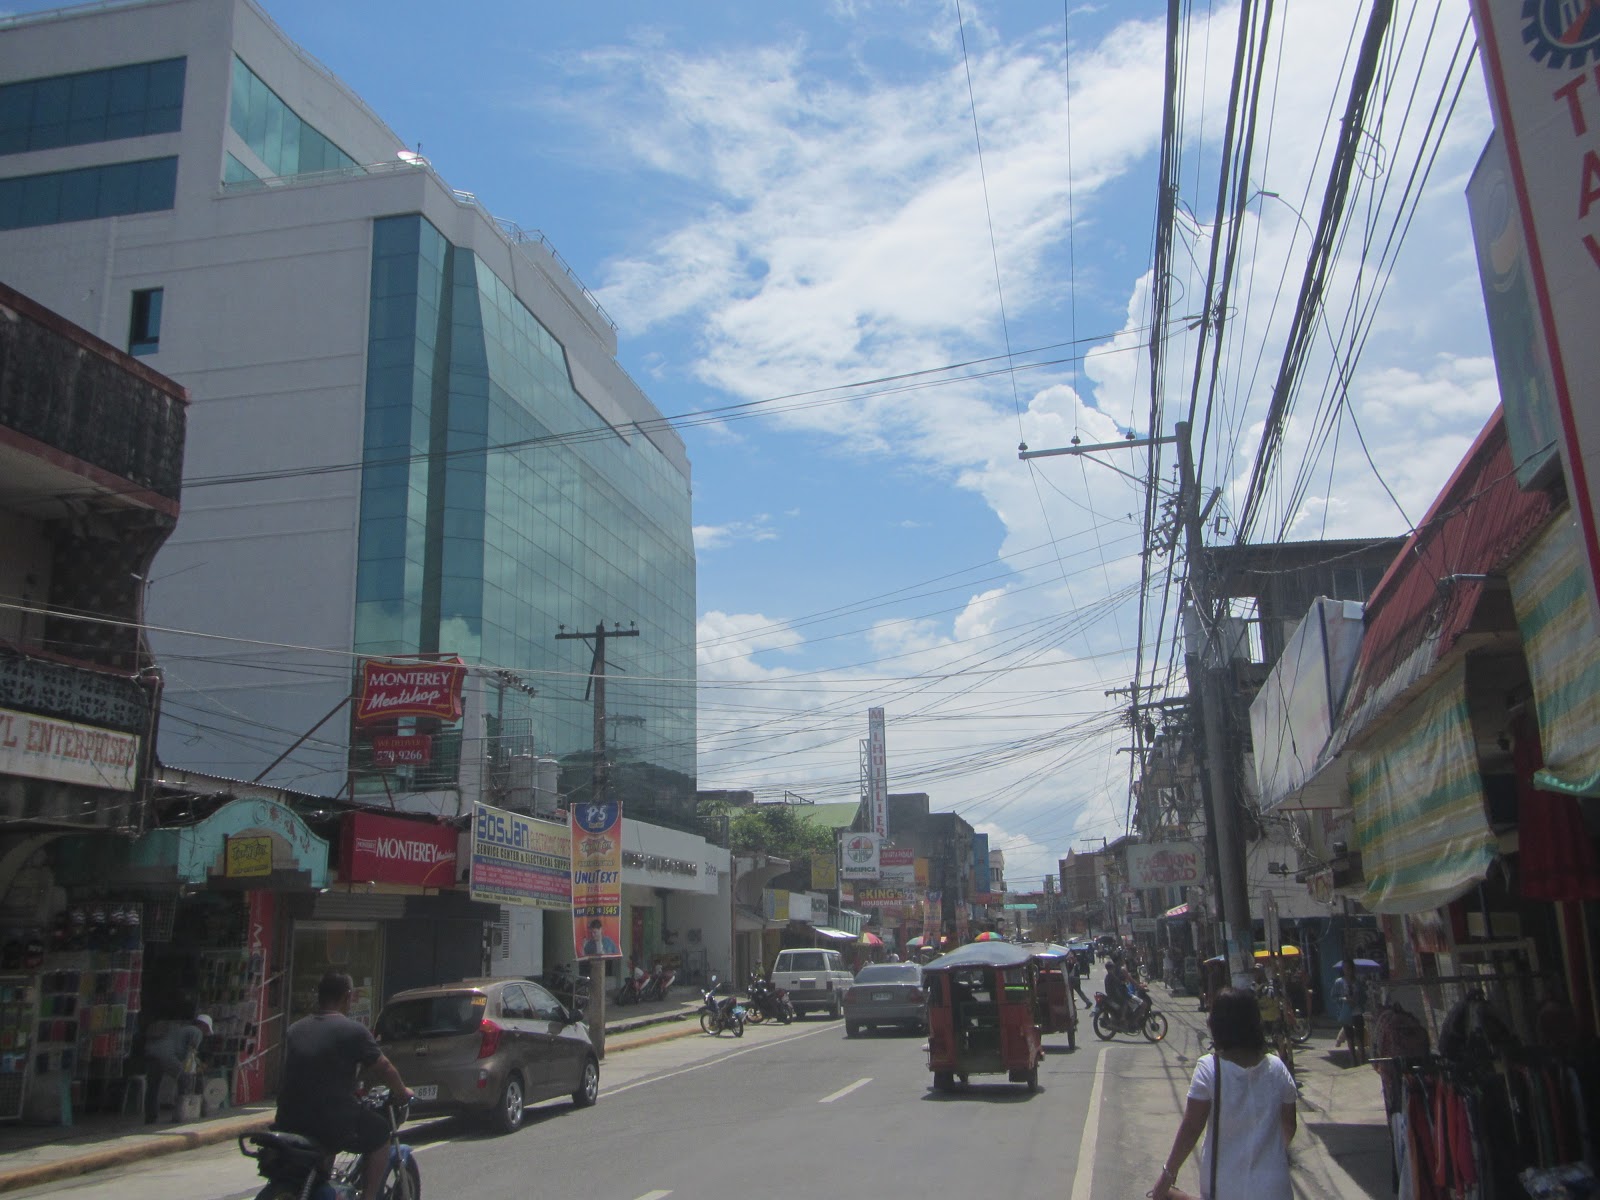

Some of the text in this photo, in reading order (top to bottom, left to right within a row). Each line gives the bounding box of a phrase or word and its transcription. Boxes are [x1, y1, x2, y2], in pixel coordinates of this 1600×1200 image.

[369, 671, 451, 687] MONTEREY
[366, 686, 441, 710] Meatshop
[376, 837, 438, 863] MONTEREY
[476, 843, 499, 858] SERVICE
[500, 847, 519, 862] CENTER
[525, 853, 553, 867] ELECTRICAL
